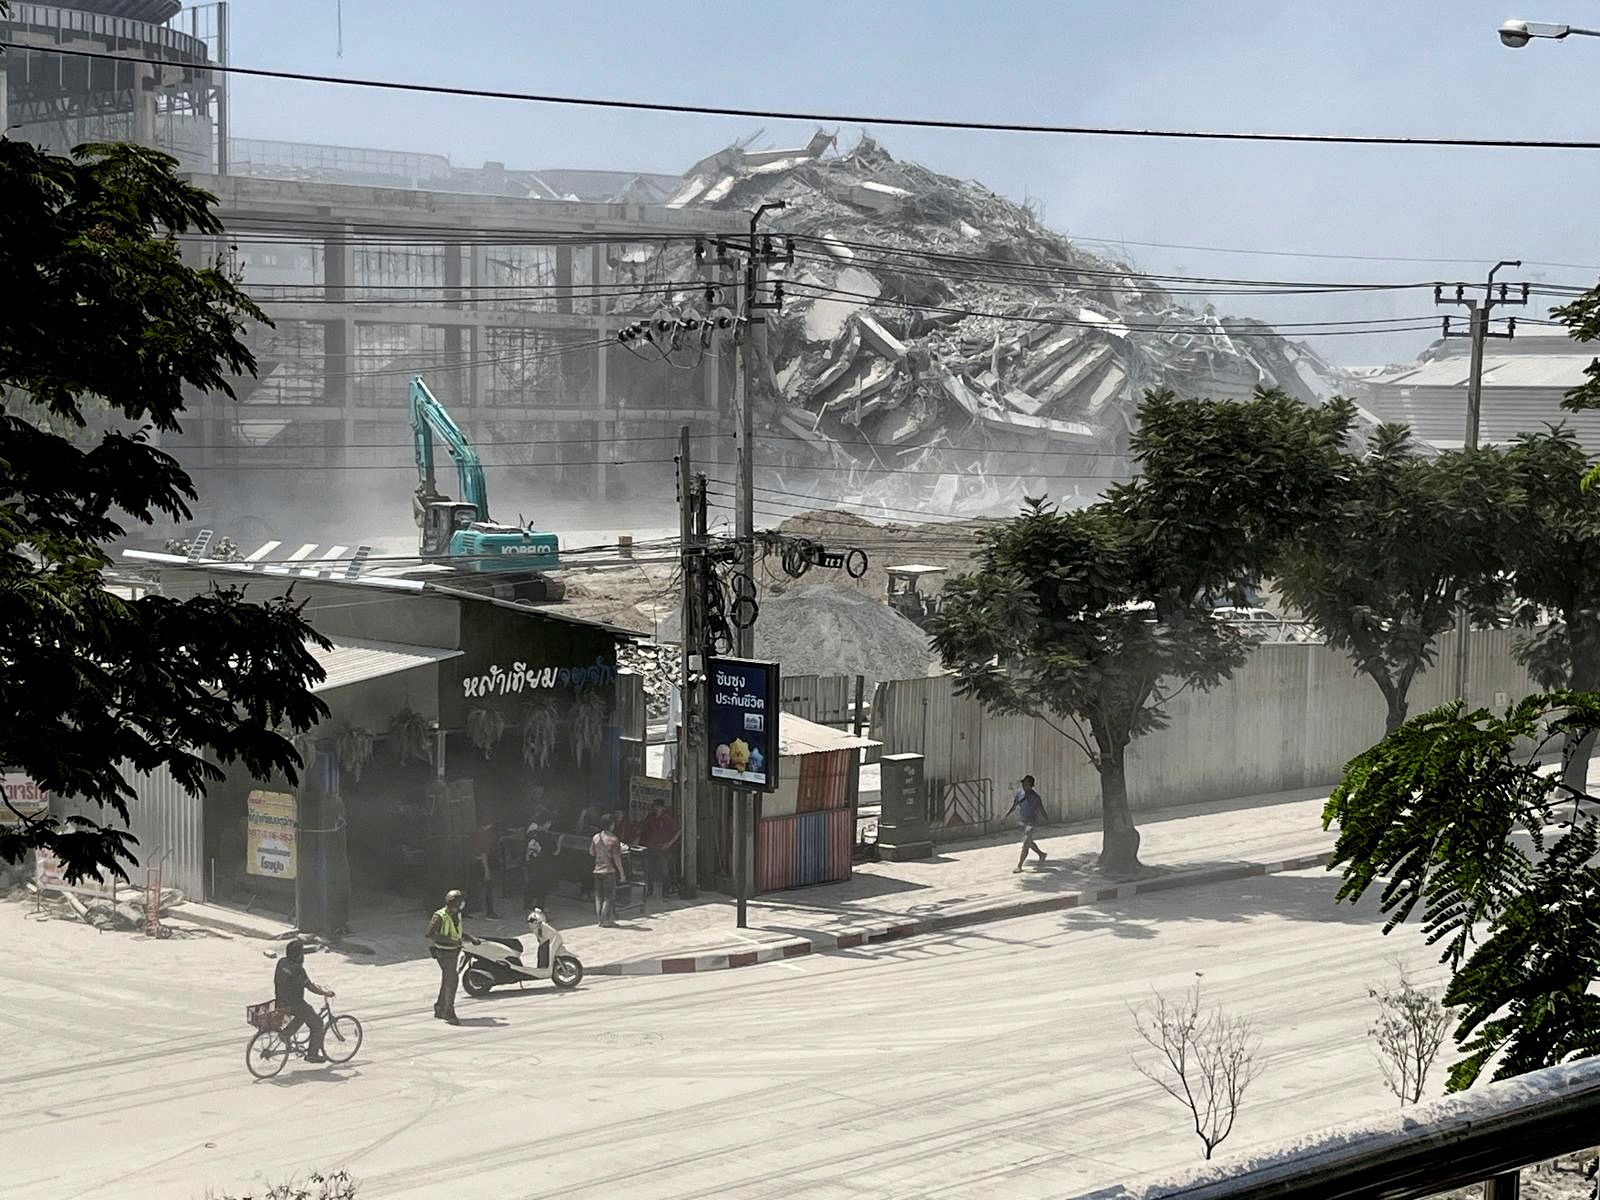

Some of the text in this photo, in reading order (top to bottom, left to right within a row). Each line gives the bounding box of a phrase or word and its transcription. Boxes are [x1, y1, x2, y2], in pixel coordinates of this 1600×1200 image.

[716, 671, 746, 692] ซัมซุง
[715, 692, 765, 710] ประกันชีวิต
